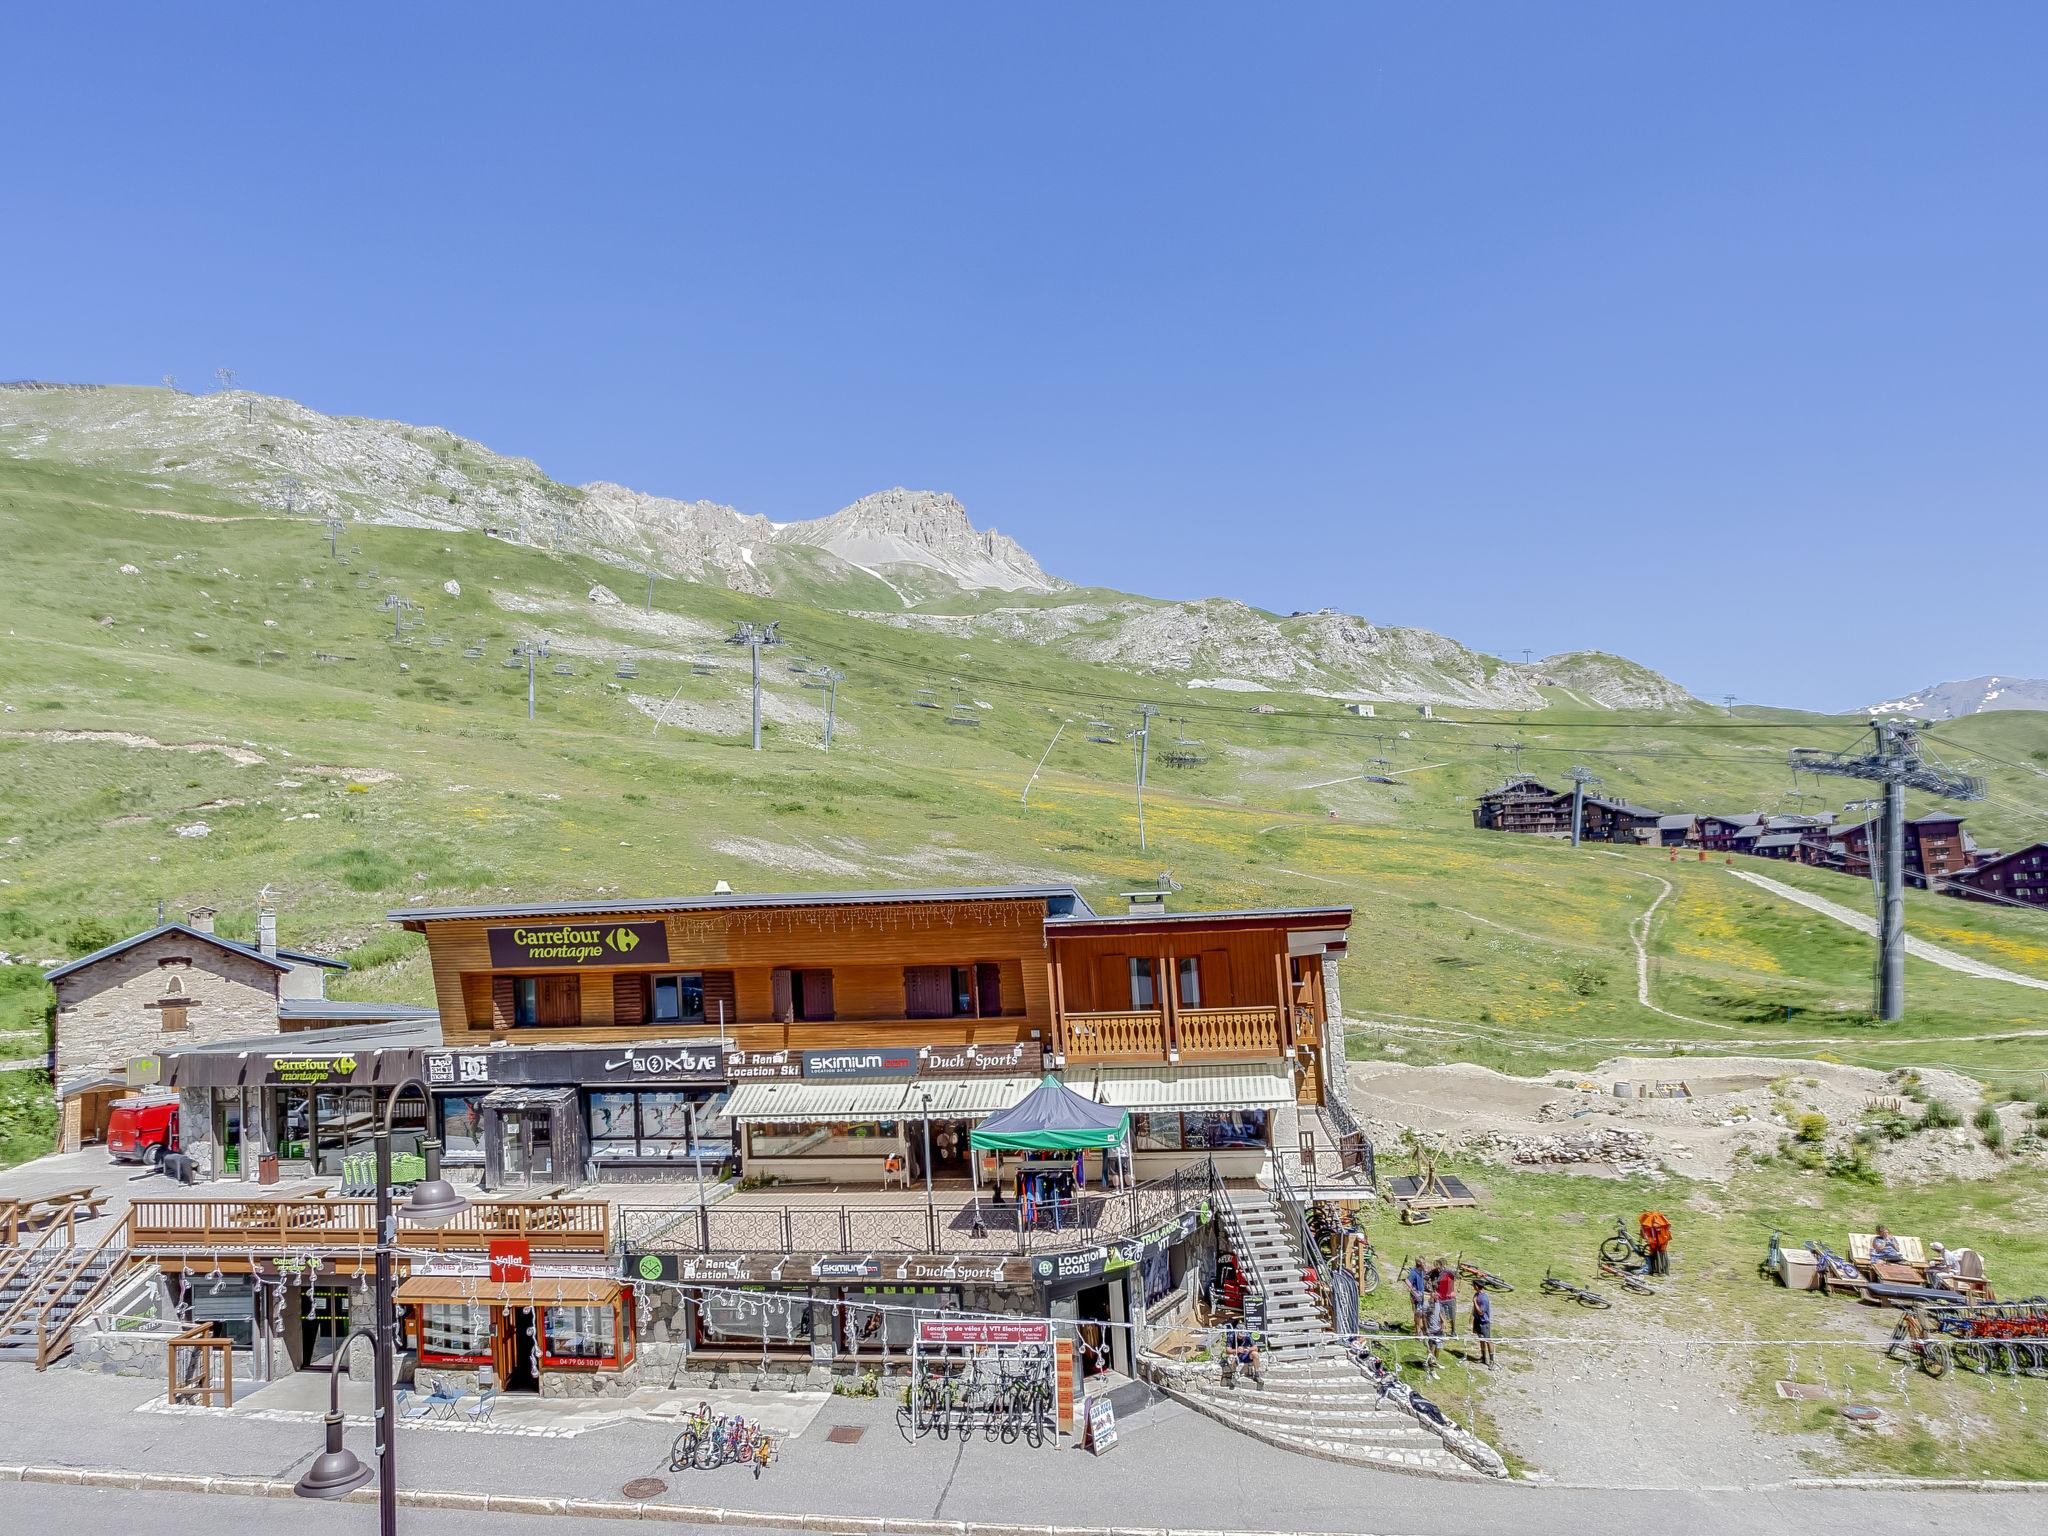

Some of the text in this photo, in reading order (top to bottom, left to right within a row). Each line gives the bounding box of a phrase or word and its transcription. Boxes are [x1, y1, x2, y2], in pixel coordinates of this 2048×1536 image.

[514, 927, 601, 945] Carrefour
[529, 945, 603, 963] montagne
[273, 1058, 331, 1071] Carrefour
[752, 1052, 788, 1065] Renl
[929, 1053, 1018, 1070] Duch Sports
[281, 1071, 329, 1085] montagne
[727, 1065, 800, 1077] Location Ski
[1157, 1235, 1170, 1252] VTT
[496, 1254, 523, 1266] Vallat
[1059, 1262, 1090, 1277] ECOLE
[568, 1358, 577, 1366] 79
[577, 1358, 585, 1366] 06
